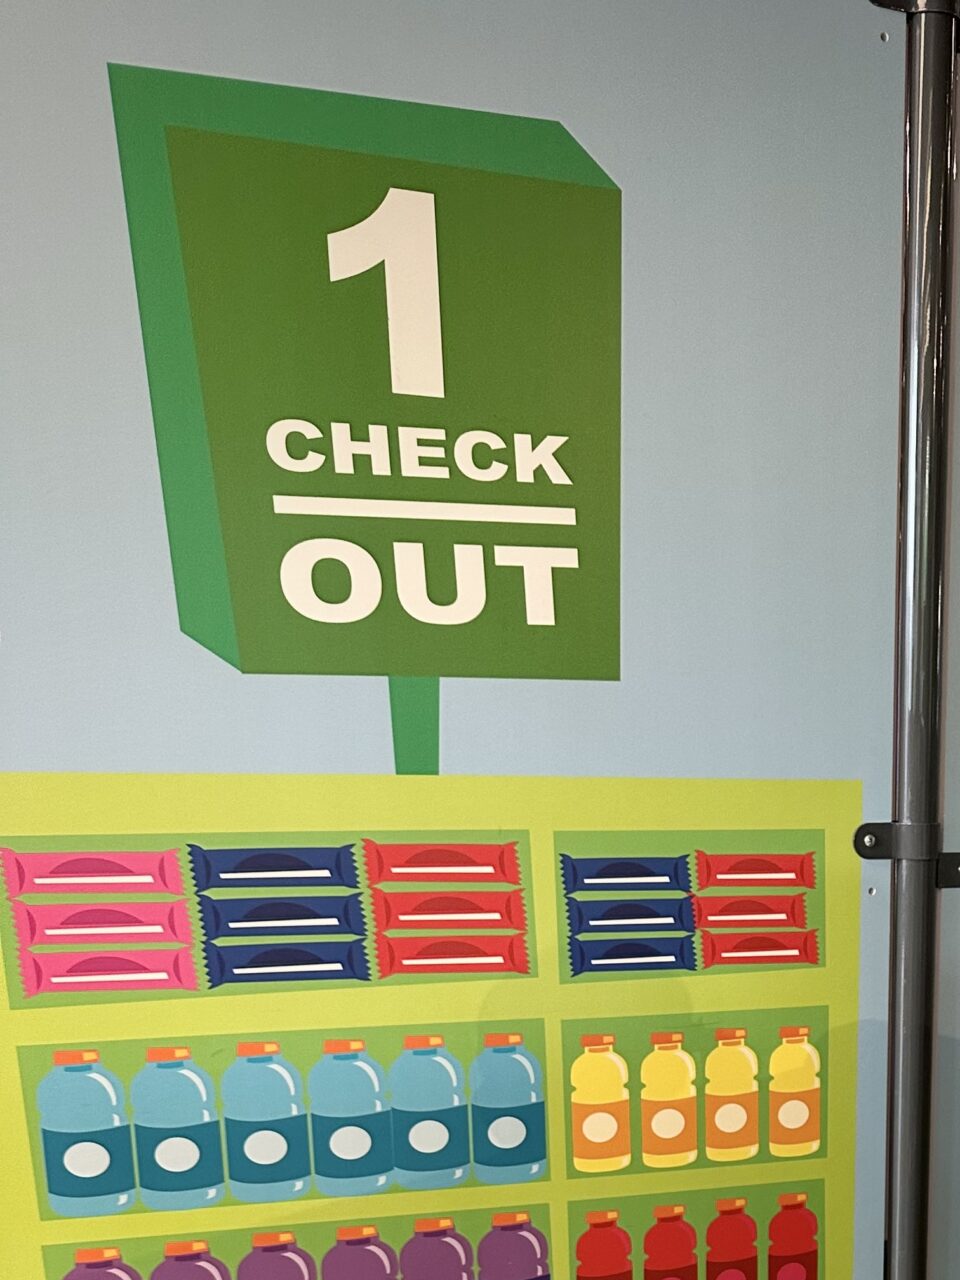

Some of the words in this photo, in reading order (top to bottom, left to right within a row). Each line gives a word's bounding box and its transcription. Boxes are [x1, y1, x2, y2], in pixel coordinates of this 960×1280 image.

[326, 186, 446, 399] 1
[265, 418, 574, 486] CHECK
[279, 537, 580, 627] OUT
